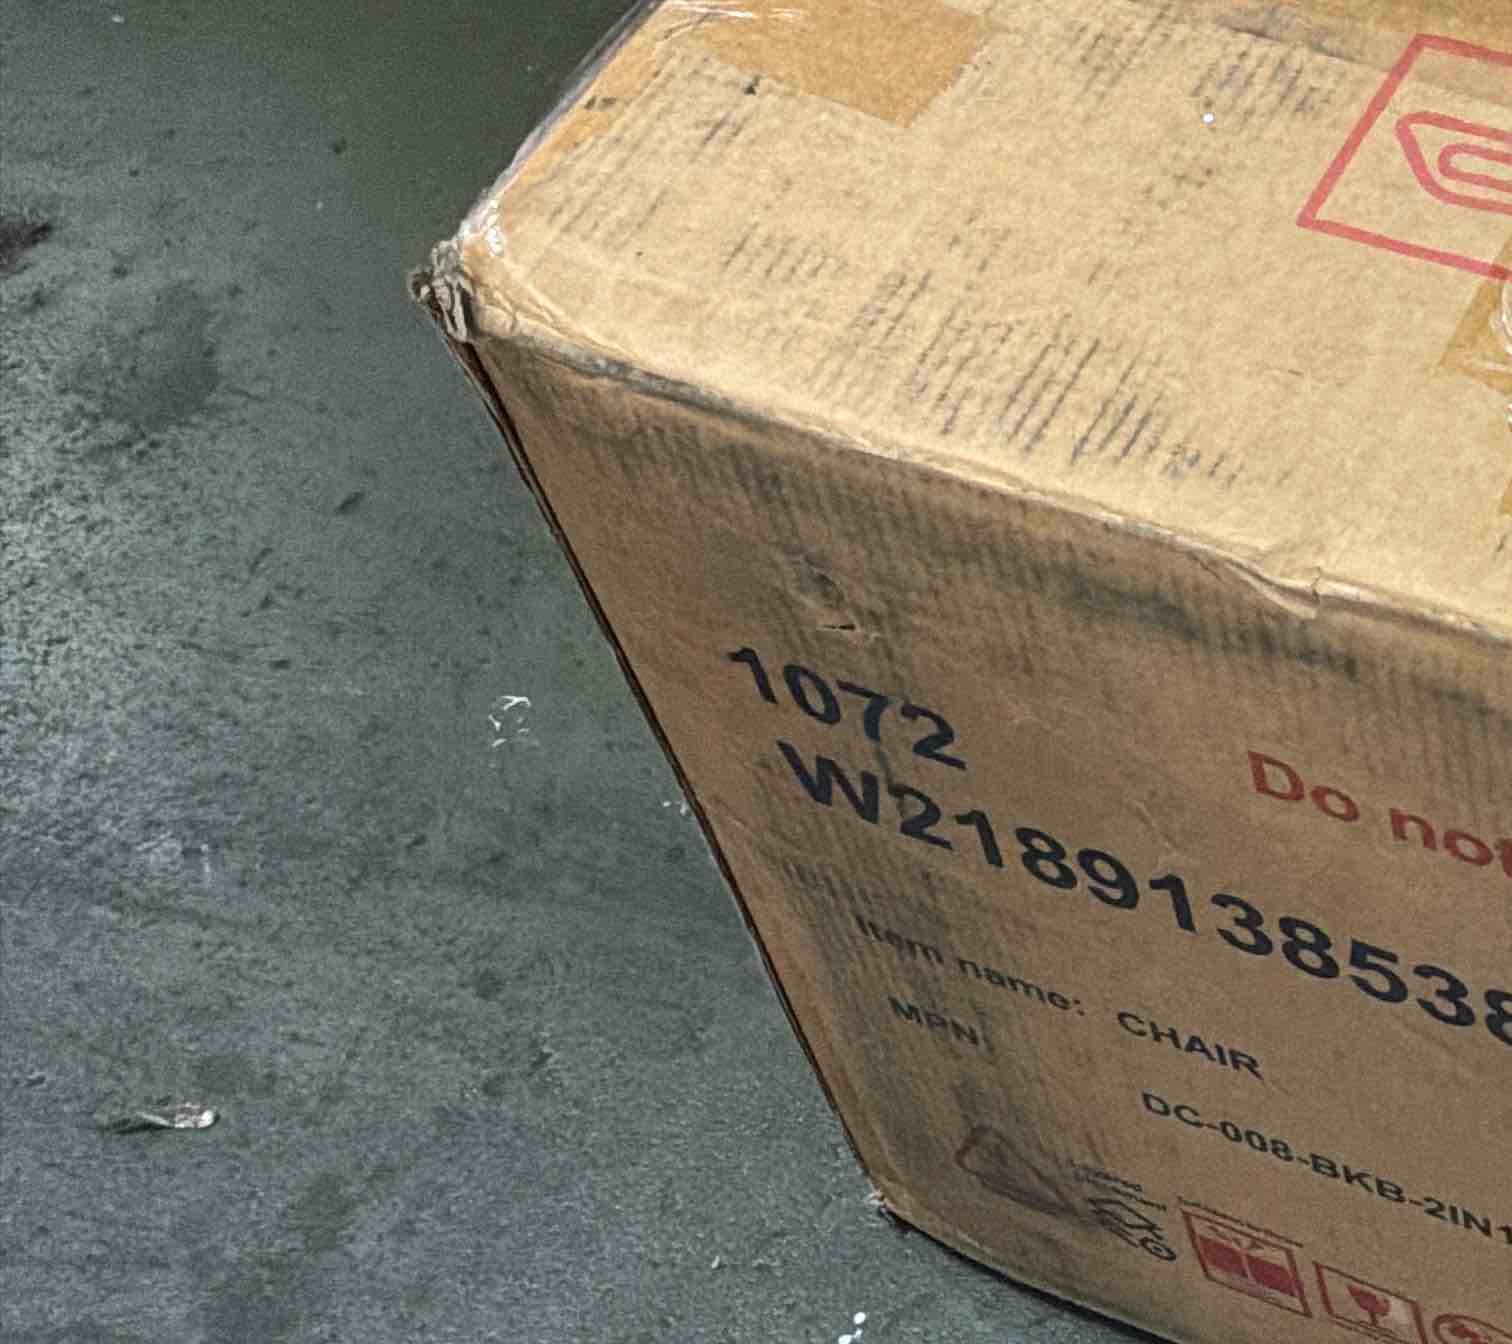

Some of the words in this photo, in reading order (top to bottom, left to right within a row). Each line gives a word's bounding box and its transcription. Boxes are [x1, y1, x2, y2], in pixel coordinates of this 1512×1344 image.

[728, 647, 968, 770] 1072
[1248, 750, 1360, 822] Do
[955, 957, 1086, 1017] name:
[1117, 1011, 1265, 1081] CHAIR
